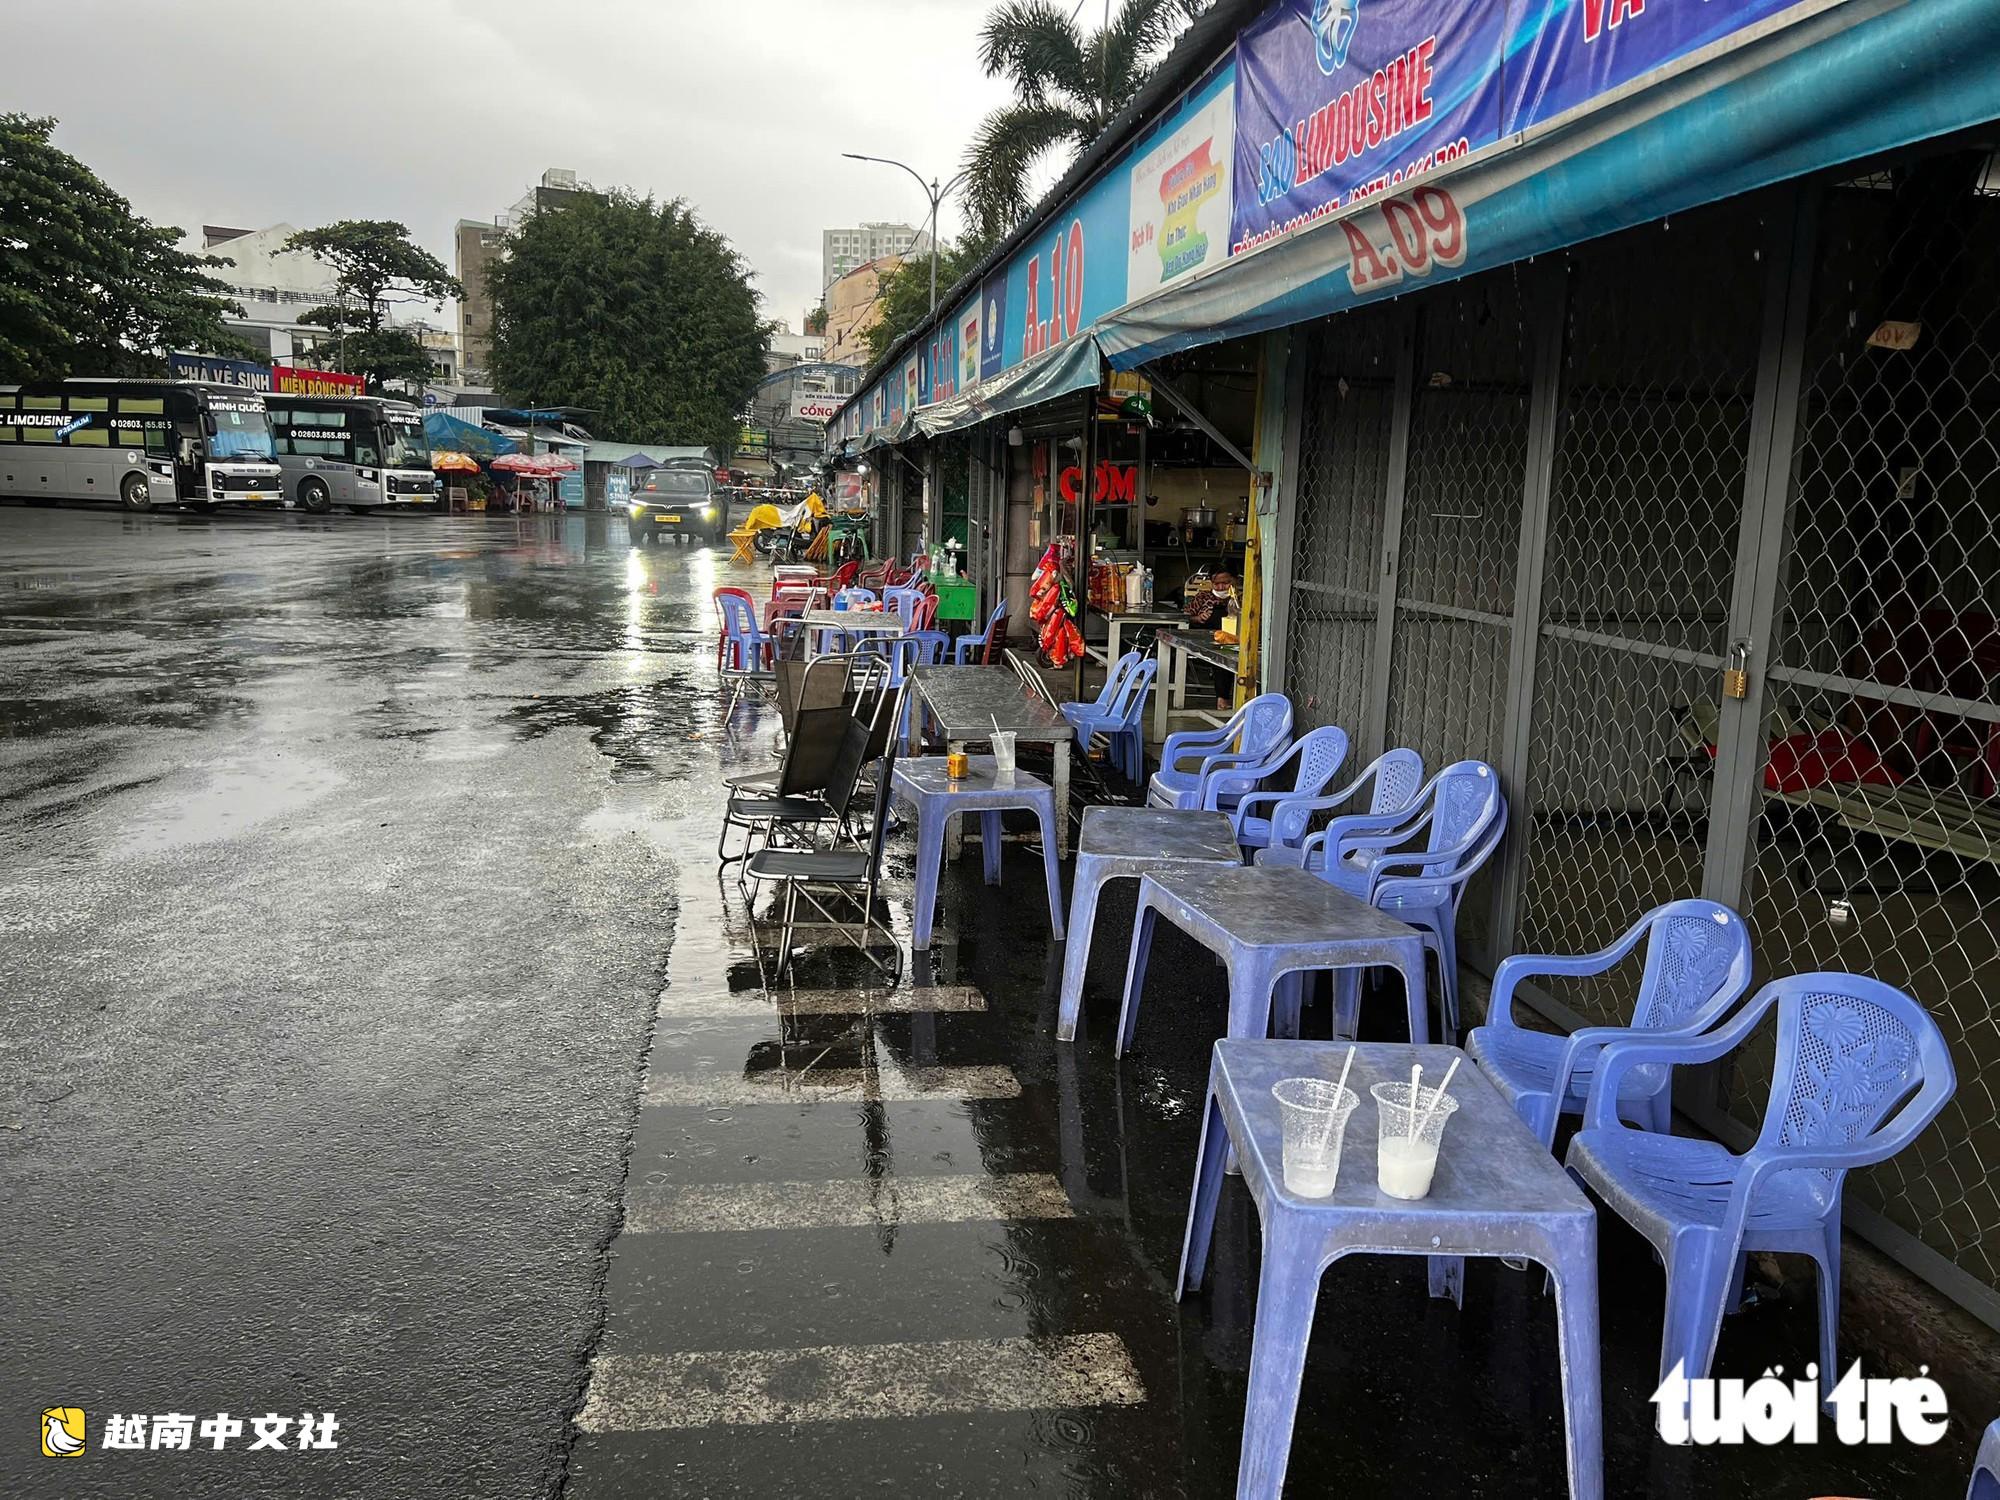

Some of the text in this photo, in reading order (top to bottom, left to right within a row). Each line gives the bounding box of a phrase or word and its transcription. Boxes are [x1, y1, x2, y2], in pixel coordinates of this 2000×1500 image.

[1258, 127, 1294, 207] SAO
[1294, 35, 1435, 187] LIMOUSINE
[1338, 186, 1462, 286] A.09
[1023, 218, 1085, 361] A.10
[237, 371, 270, 391] SINH
[280, 370, 304, 394] MIỀN
[208, 402, 266, 413] MINH QUỐC
[800, 402, 833, 416] CỔNG
[7, 415, 72, 426] LIMOUSINE
[56, 415, 91, 437] PREMIUM
[298, 430, 351, 439] 02603.855.855
